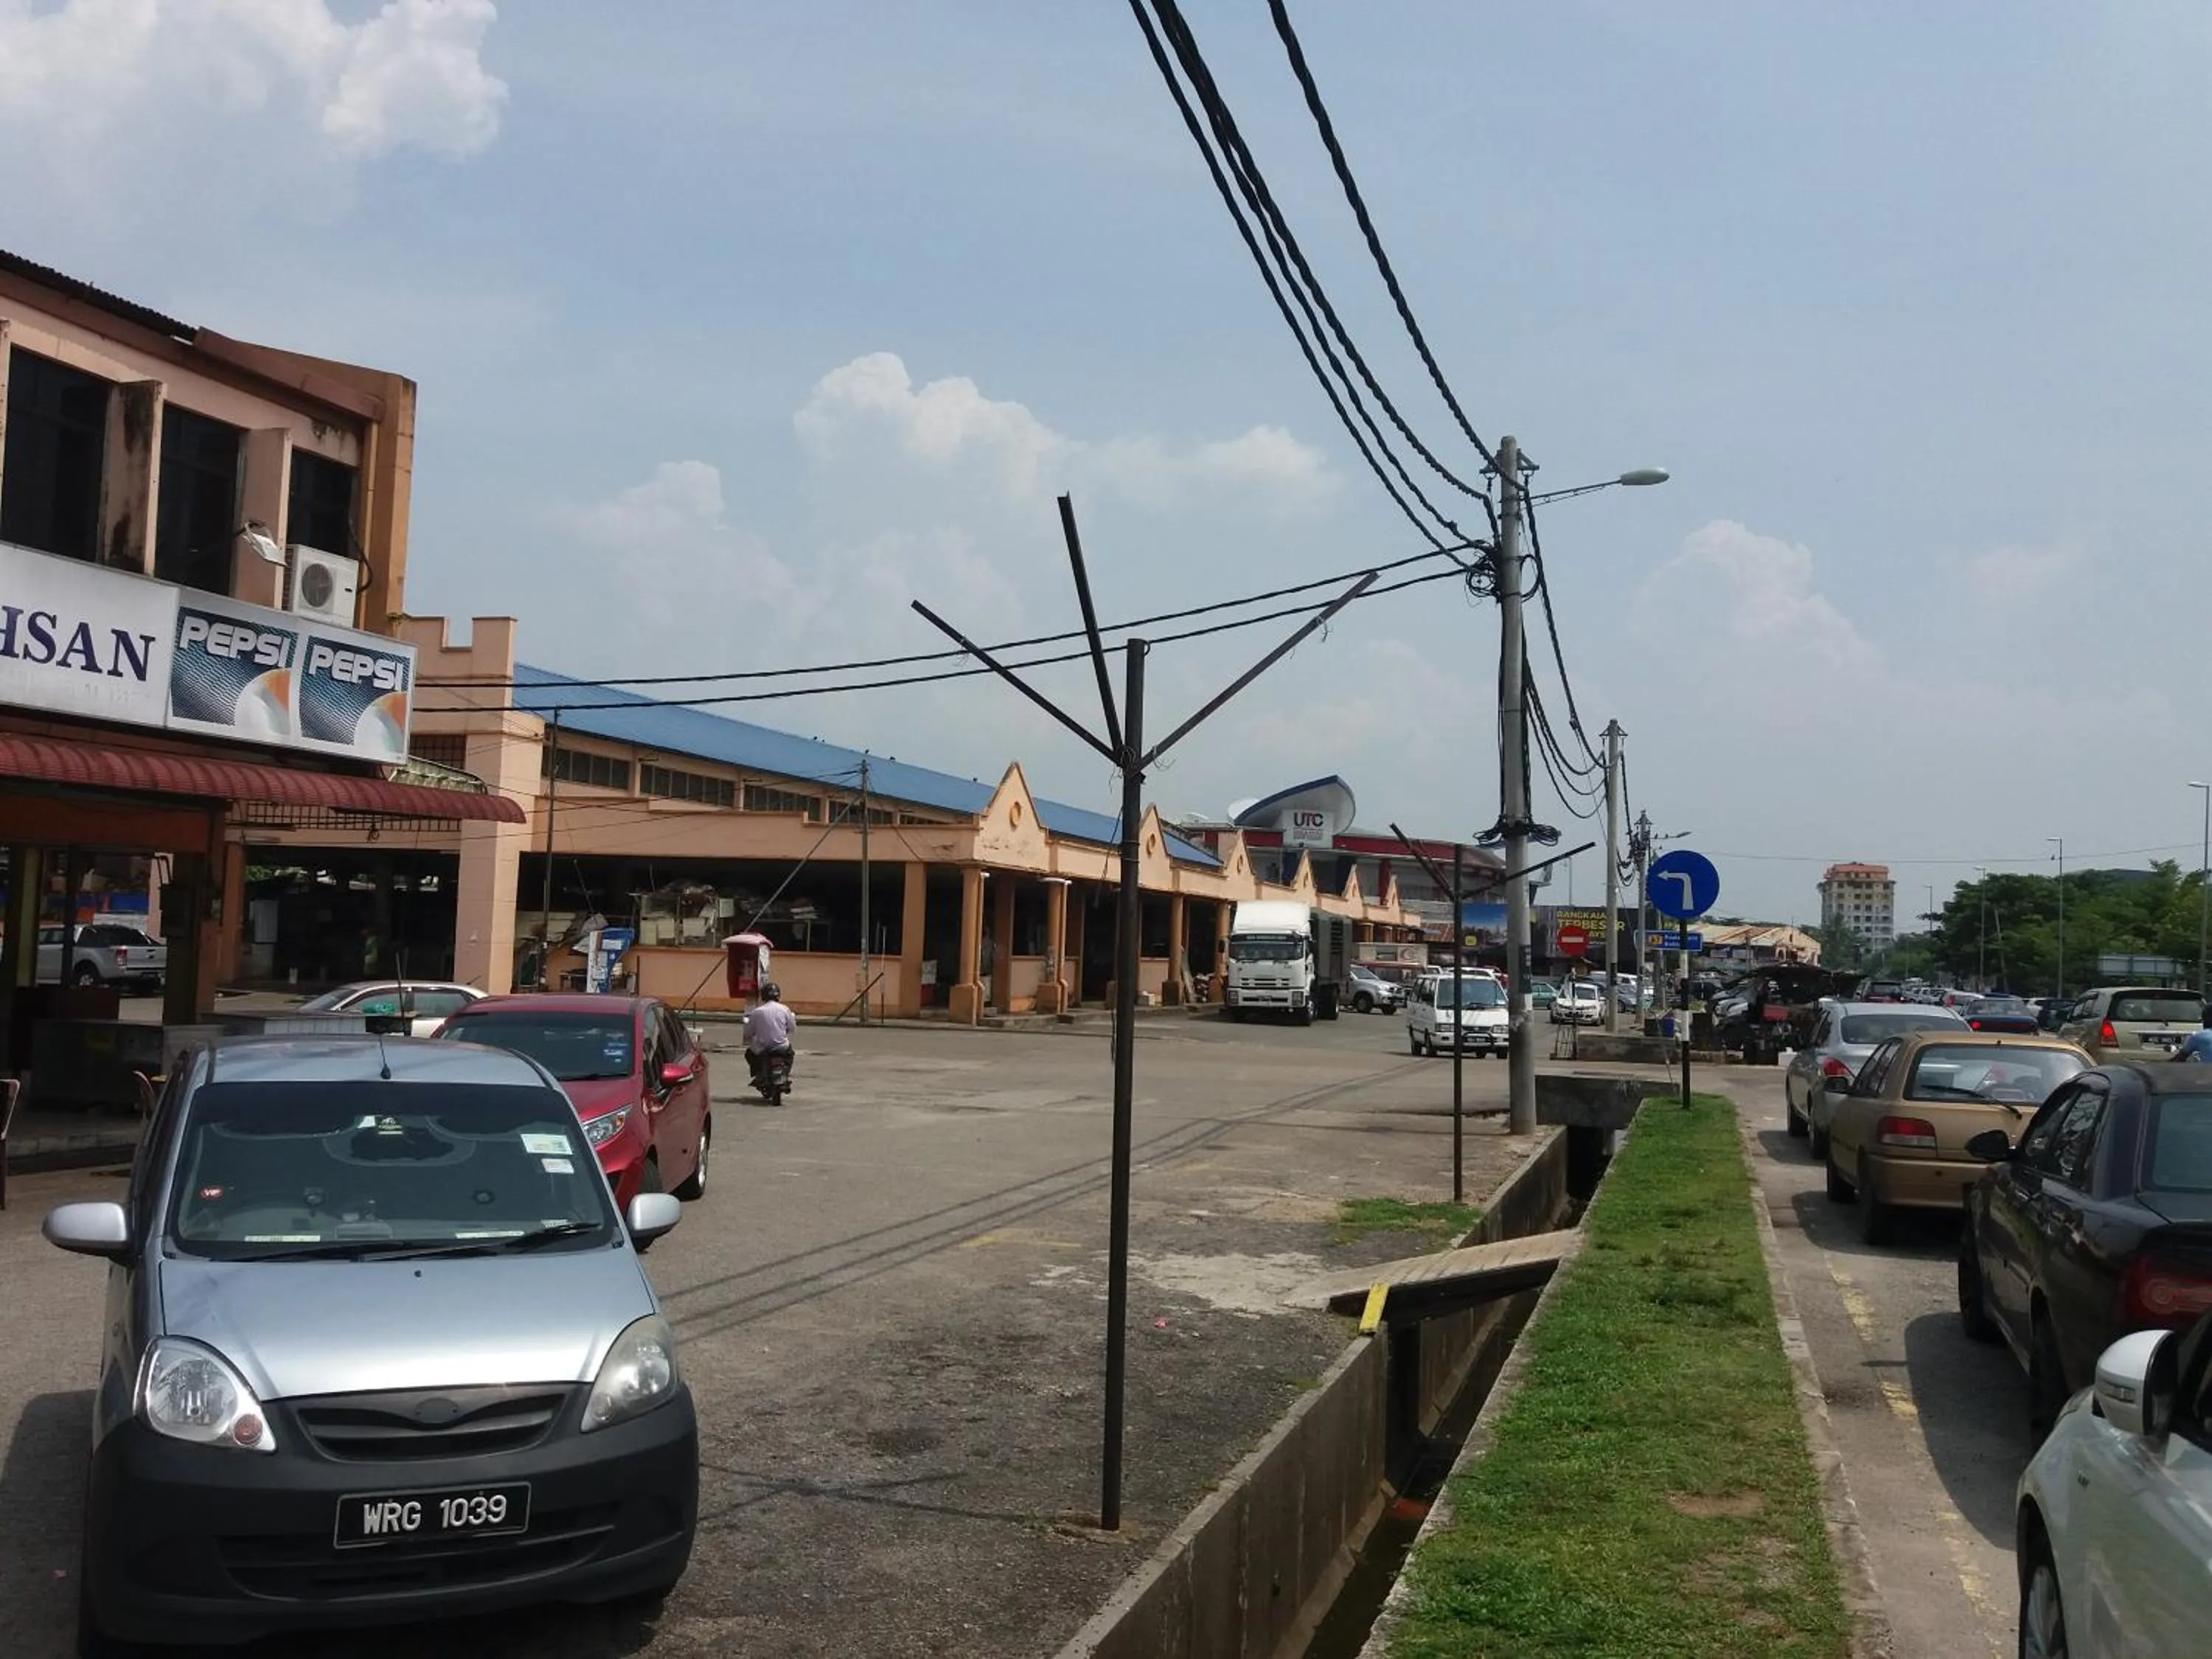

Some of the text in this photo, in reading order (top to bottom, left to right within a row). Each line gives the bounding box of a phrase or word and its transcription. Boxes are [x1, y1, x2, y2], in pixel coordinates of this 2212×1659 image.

[179, 616, 291, 667] PEPSI
[308, 645, 403, 692] PEPSI
[1294, 813, 1324, 827] UTC
[1557, 911, 1607, 919] RANGKAIA
[1557, 919, 1625, 931] TERBESR
[364, 1495, 507, 1534] WRG 1039
